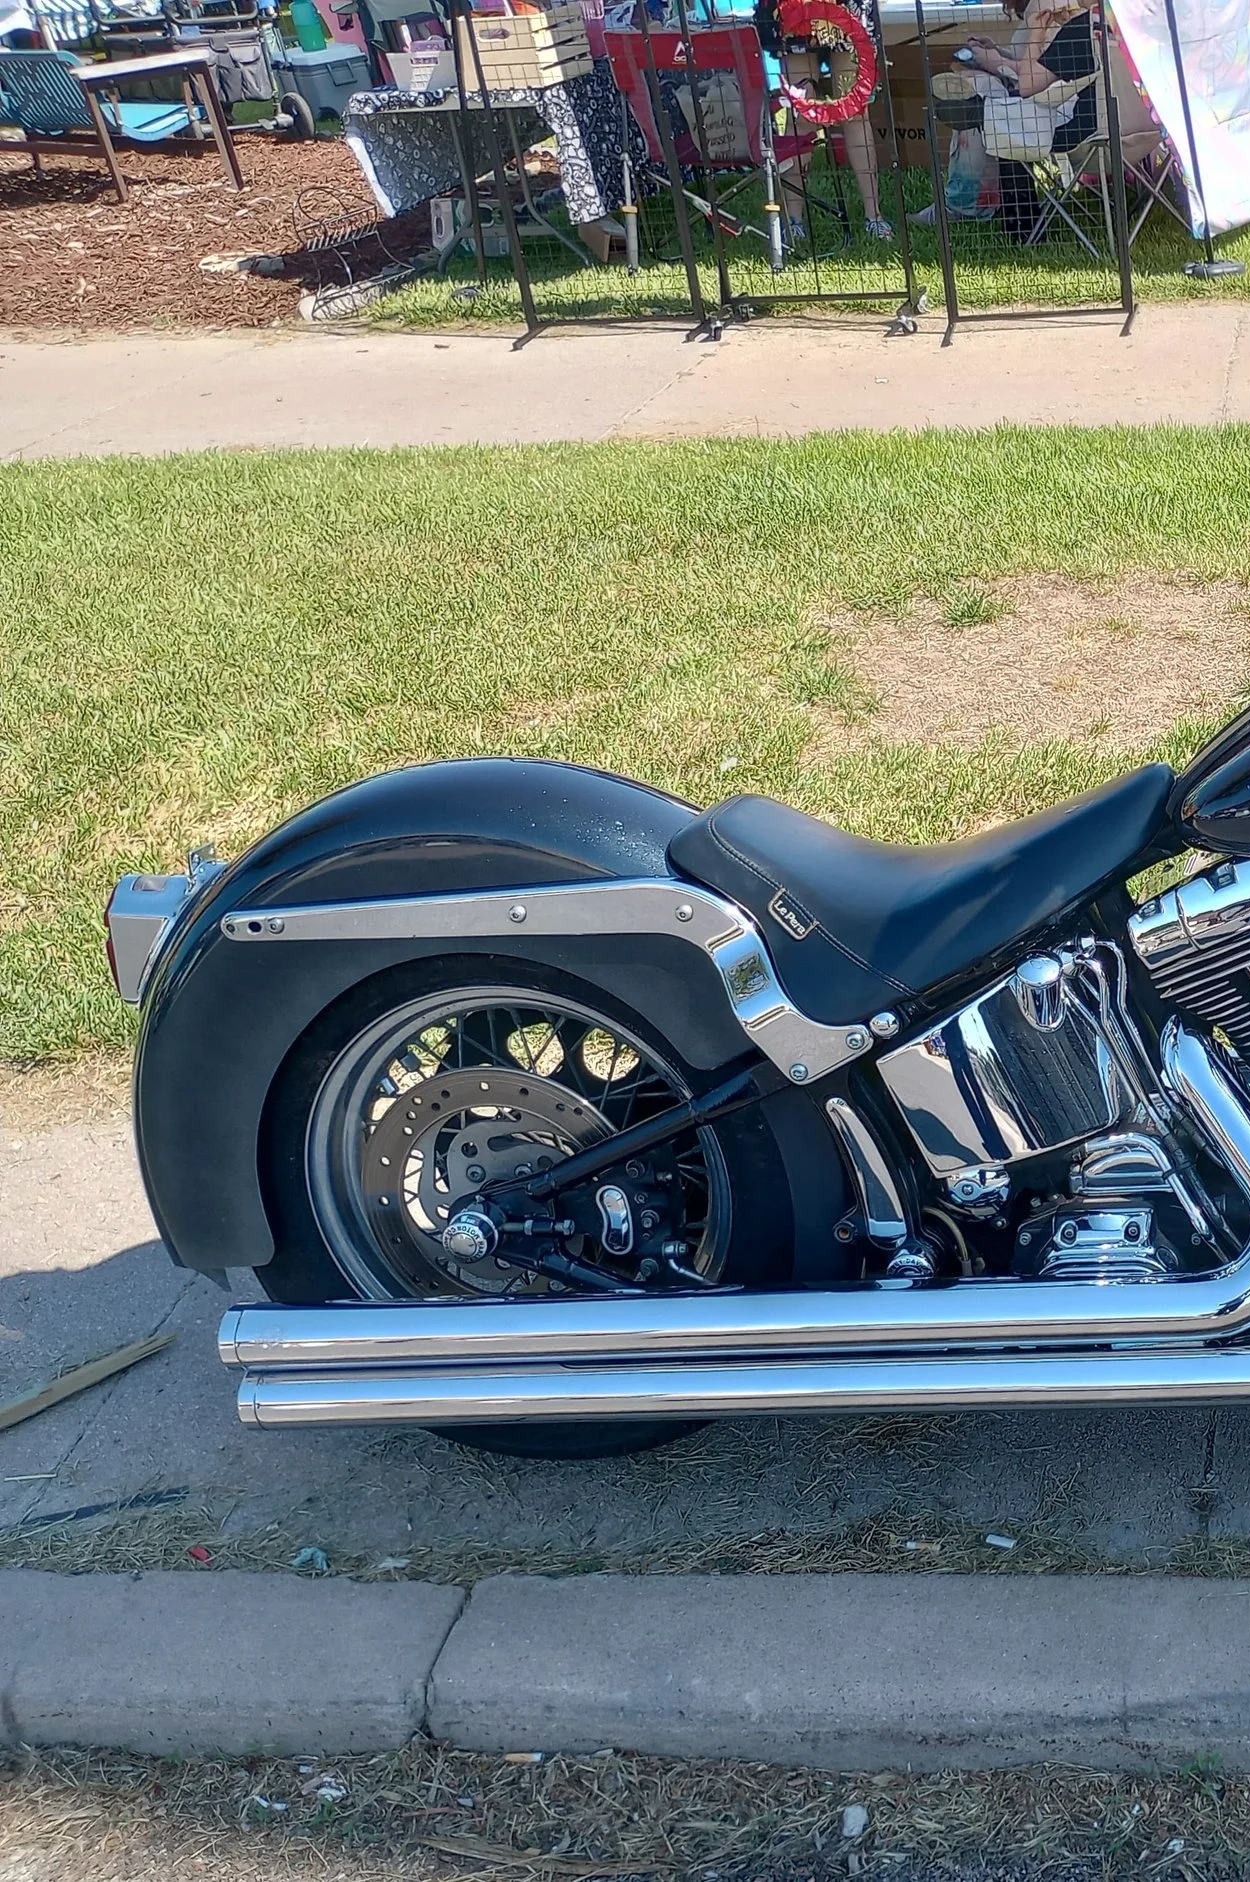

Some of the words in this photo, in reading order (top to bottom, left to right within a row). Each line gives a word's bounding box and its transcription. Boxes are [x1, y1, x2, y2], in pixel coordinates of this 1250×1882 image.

[877, 128, 926, 140] VVOR
[773, 900, 788, 916] Le
[784, 911, 806, 935] Pera
